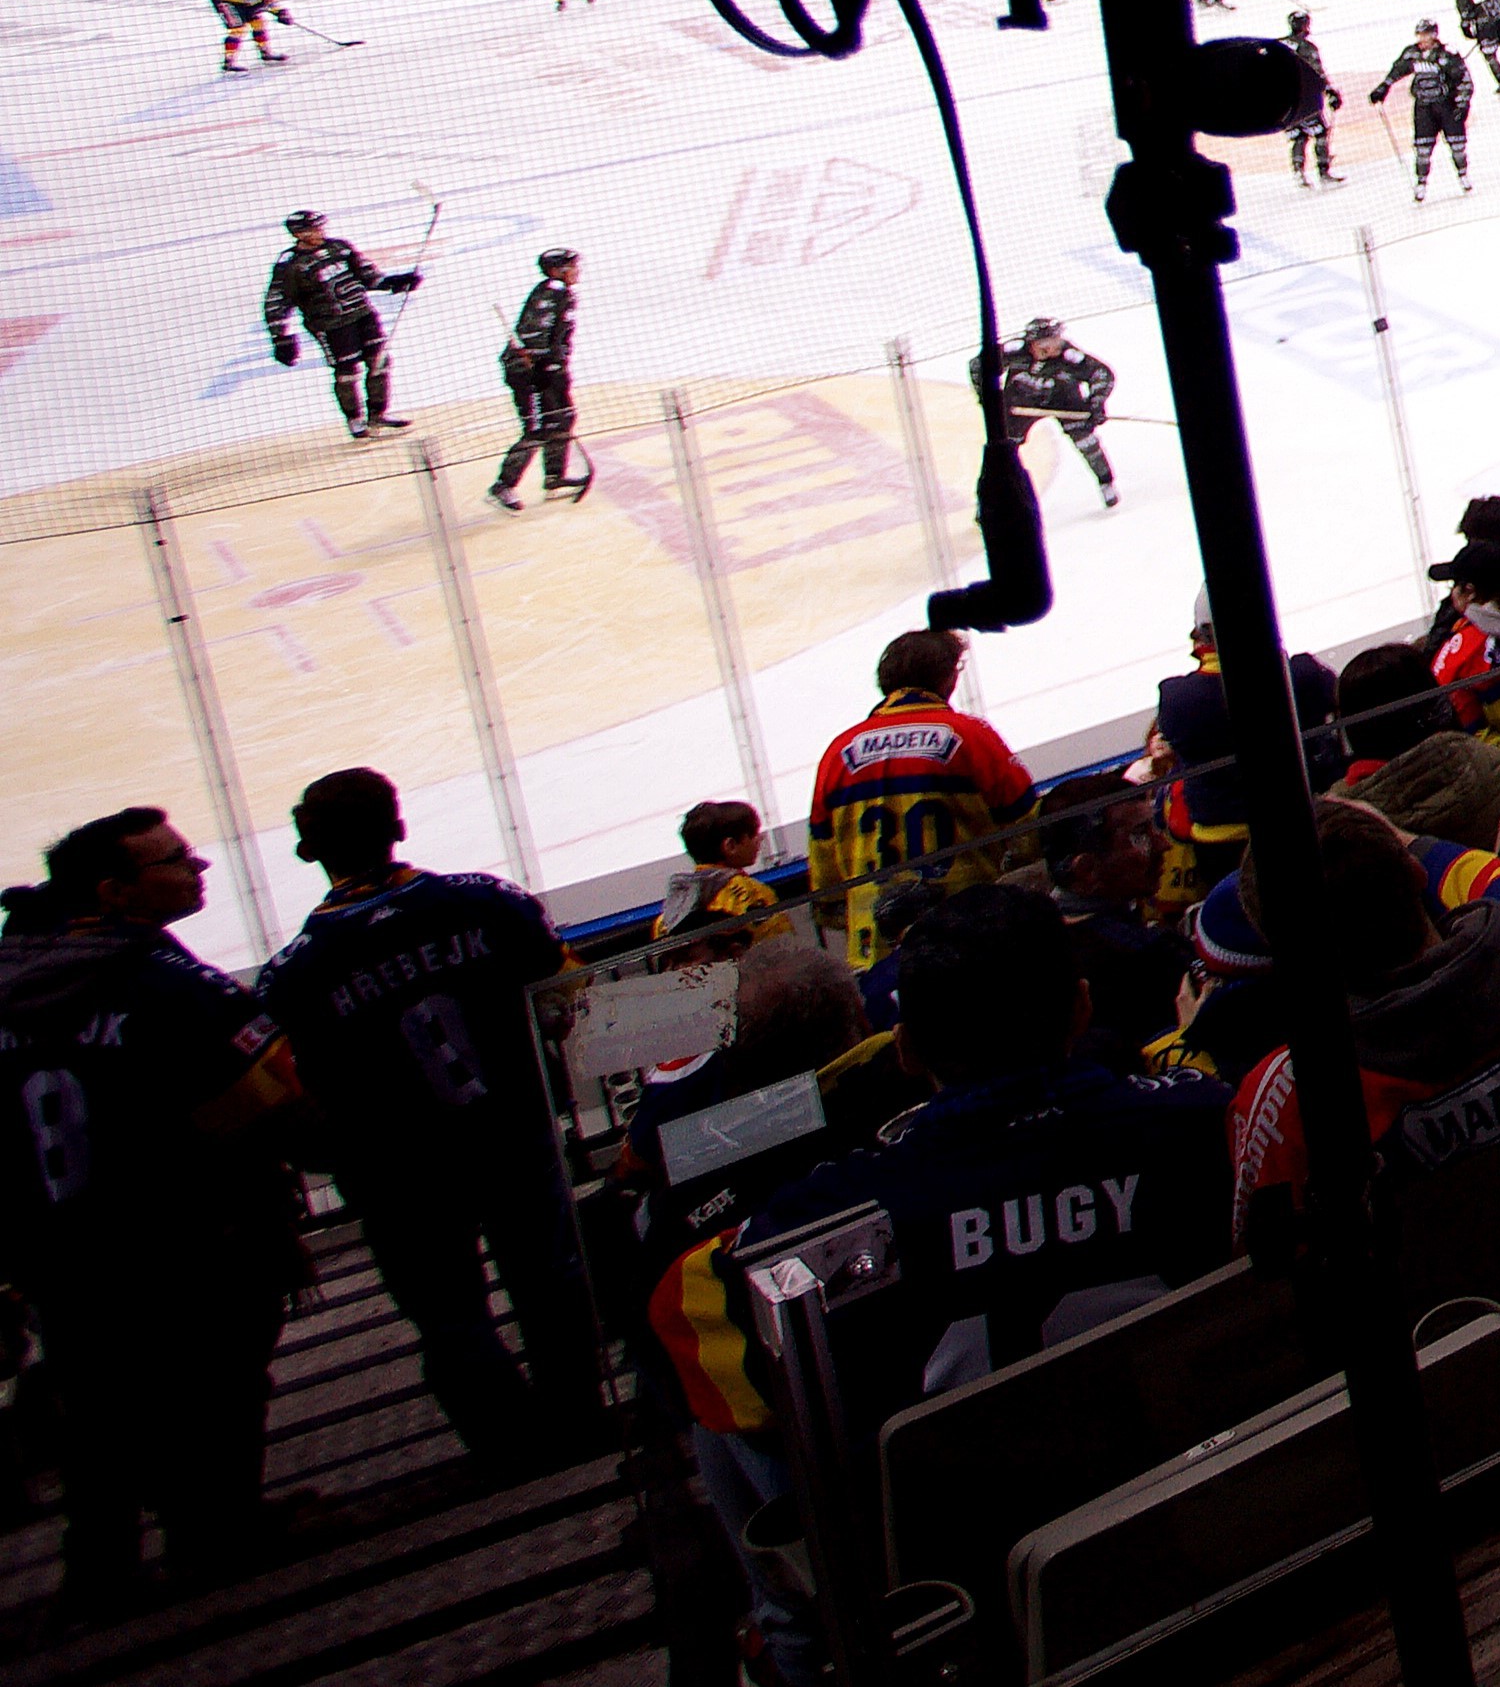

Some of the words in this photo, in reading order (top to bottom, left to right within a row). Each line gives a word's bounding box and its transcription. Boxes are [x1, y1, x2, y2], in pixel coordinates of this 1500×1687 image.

[861, 730, 943, 754] MADETA
[327, 925, 494, 1018] HŘEBEJK
[950, 1173, 1141, 1271] BUGY
